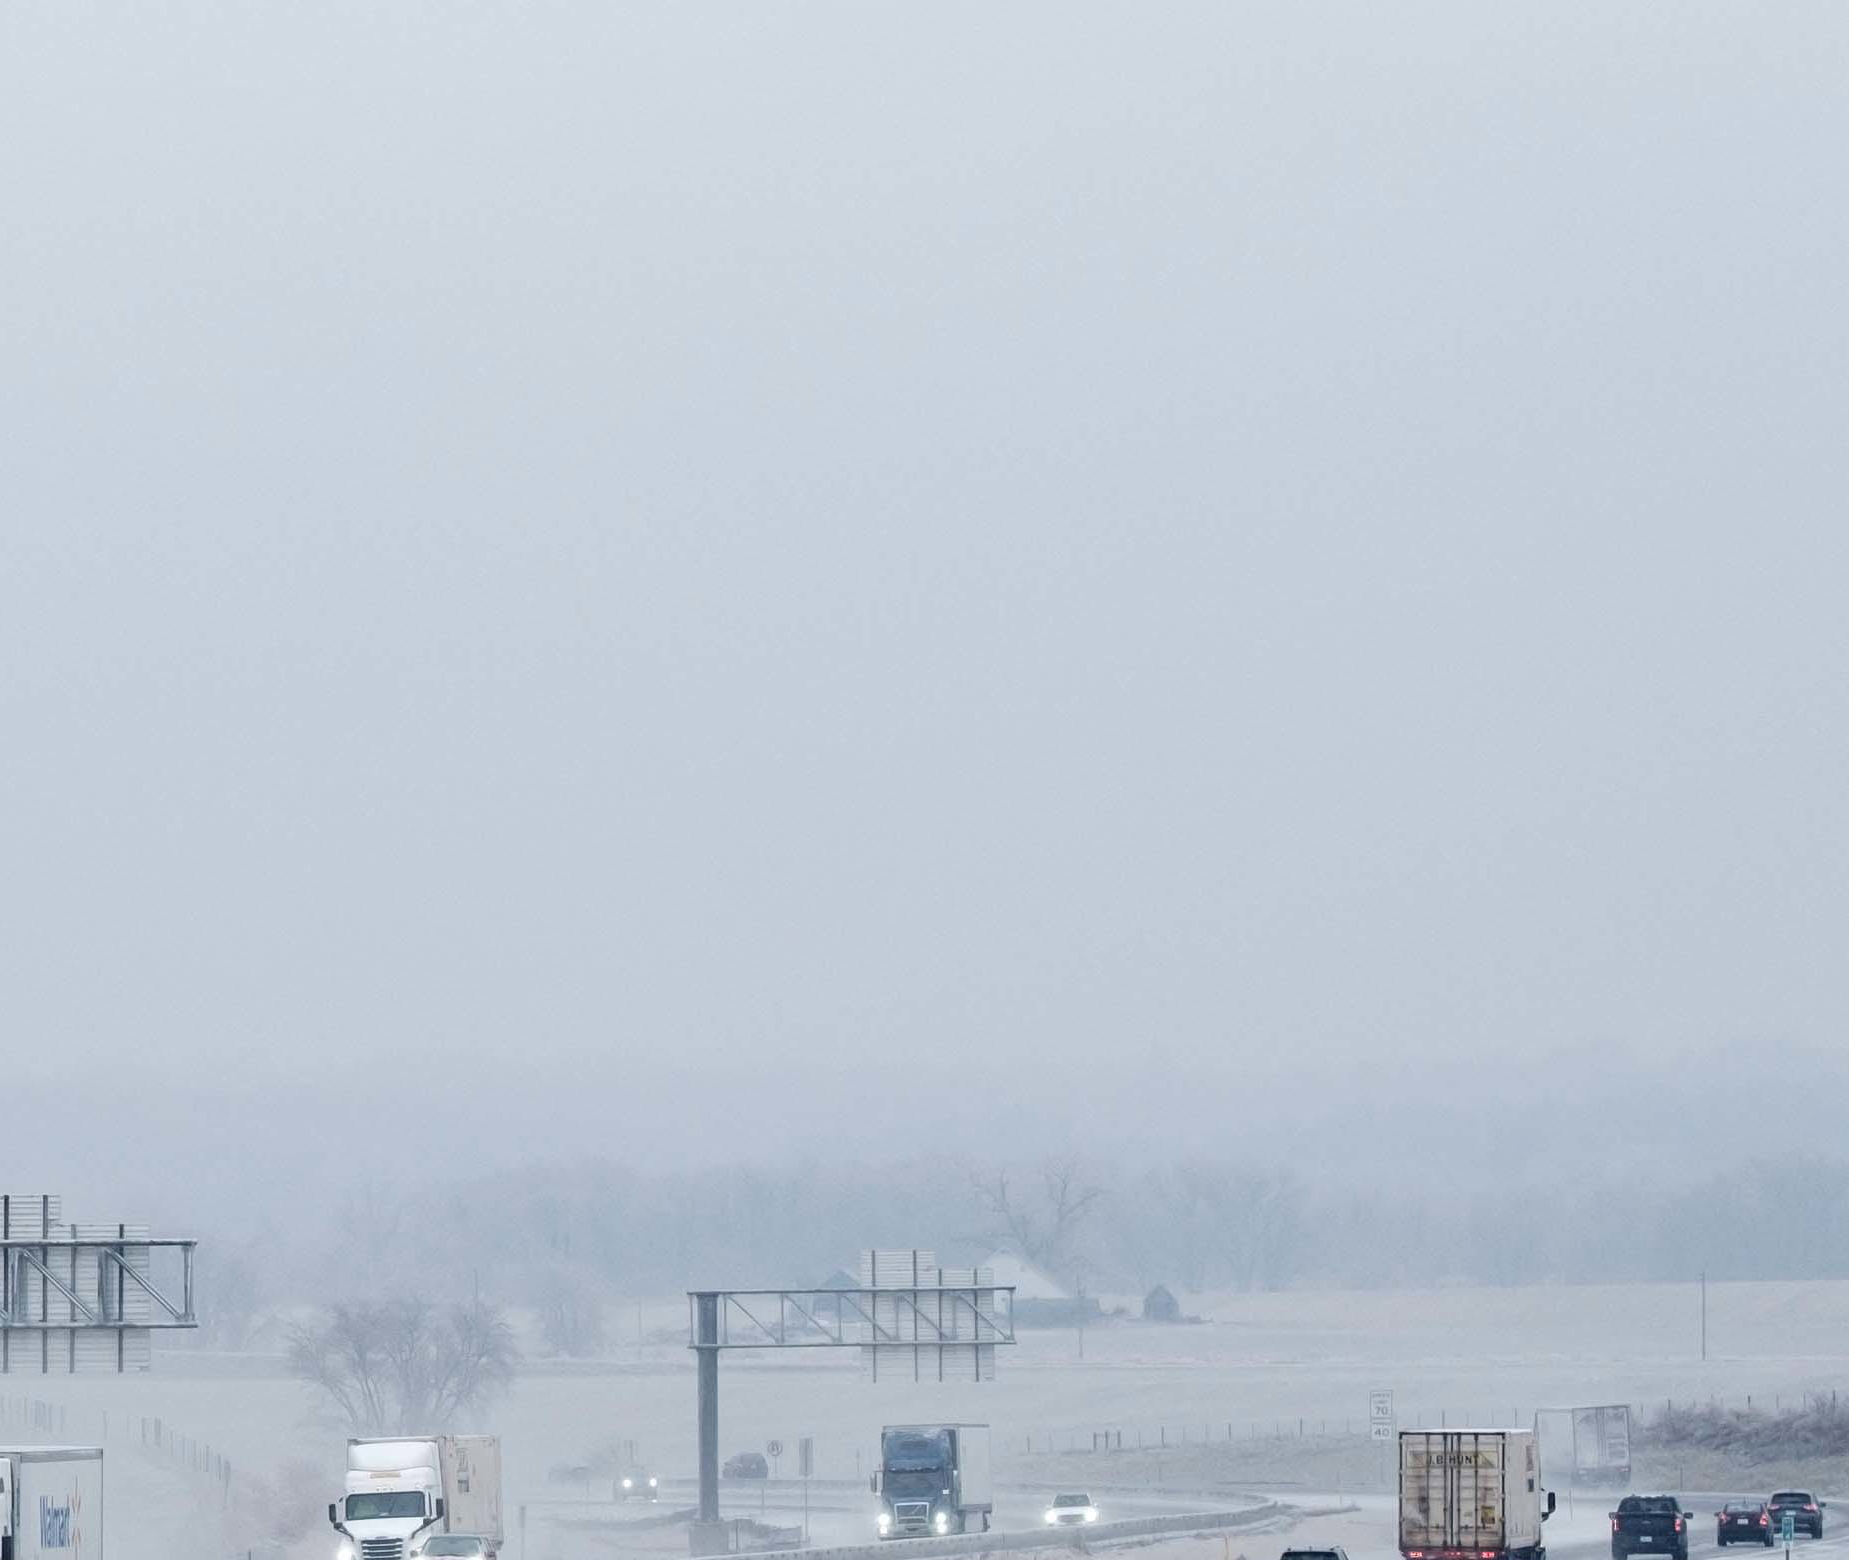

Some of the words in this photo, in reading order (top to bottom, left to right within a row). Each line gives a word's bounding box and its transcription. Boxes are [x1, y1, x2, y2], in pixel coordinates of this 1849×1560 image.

[1375, 1406, 1388, 1416] 70
[1374, 1428, 1390, 1437] 40
[1449, 1454, 1480, 1465] HUNT
[39, 1495, 71, 1549] Walmart
